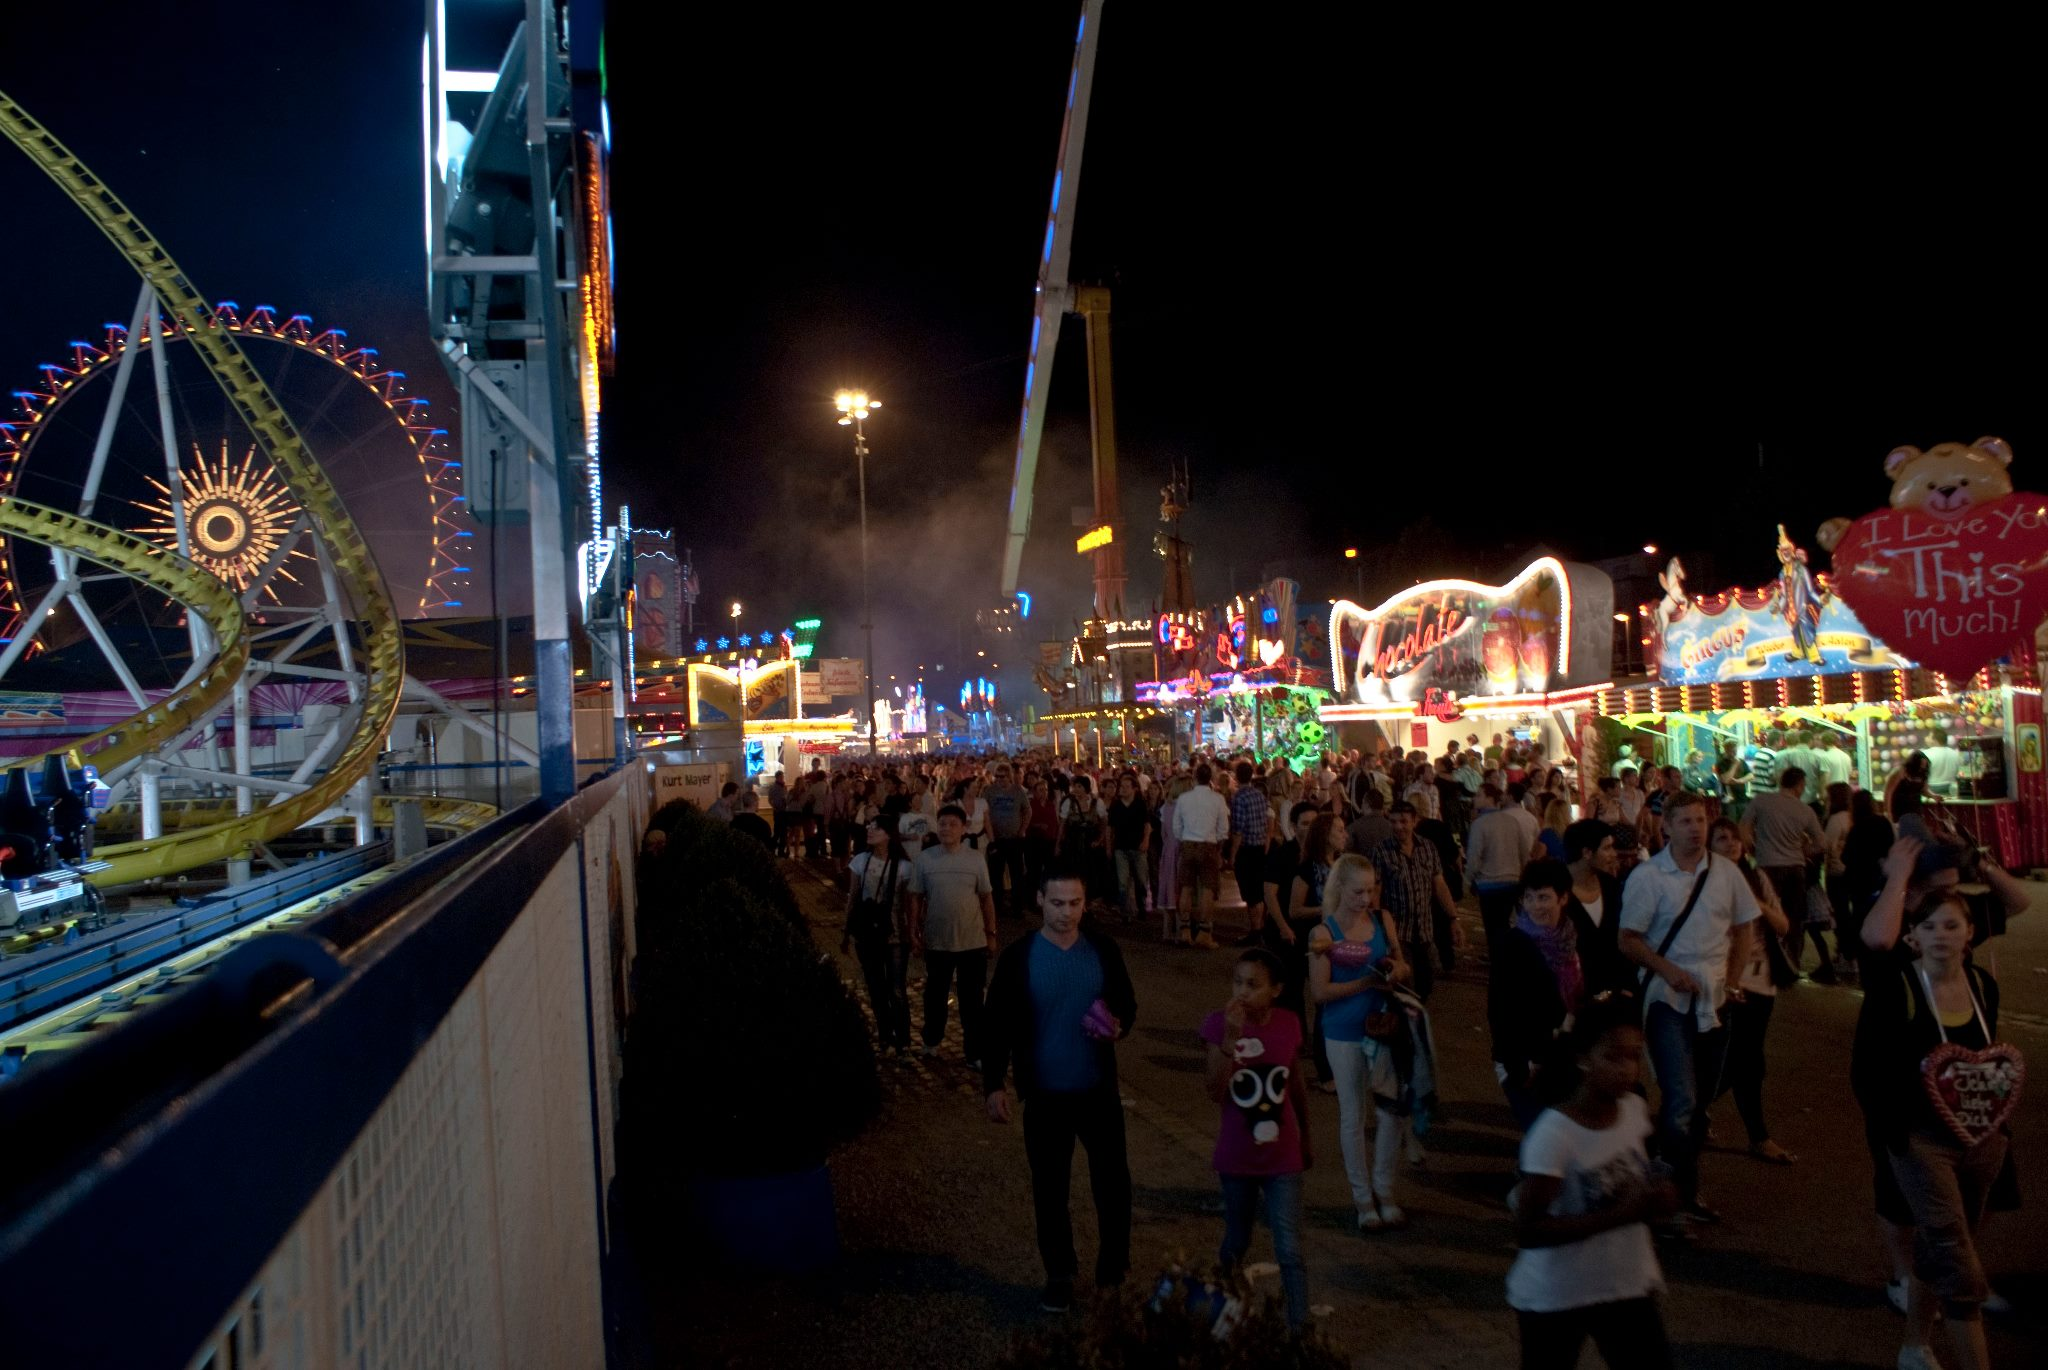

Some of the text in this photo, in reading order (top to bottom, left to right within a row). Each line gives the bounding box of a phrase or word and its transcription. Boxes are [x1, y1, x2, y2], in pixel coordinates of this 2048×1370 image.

[1862, 515, 1891, 548] I
[1902, 514, 1988, 542] Love
[1879, 540, 2024, 603] This
[662, 775, 682, 787] Kurt
[685, 773, 712, 787] Mayer
